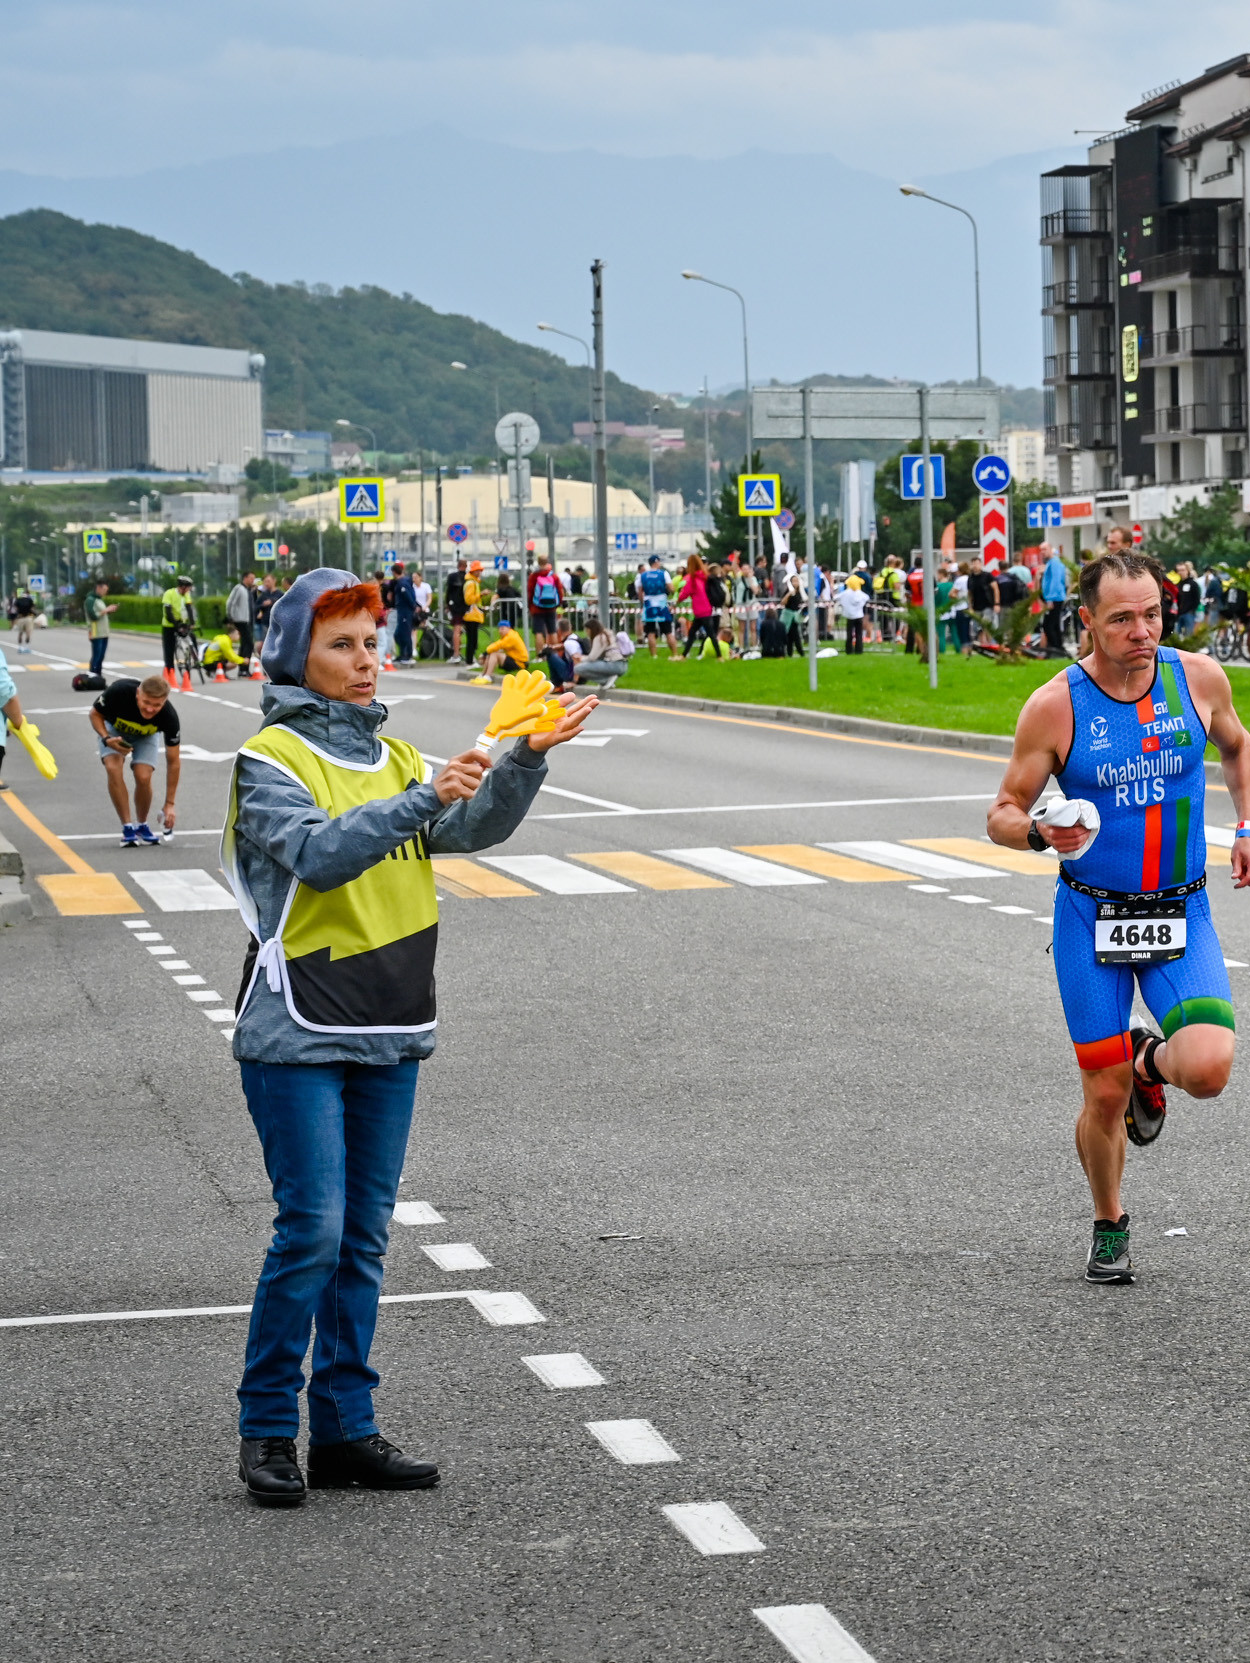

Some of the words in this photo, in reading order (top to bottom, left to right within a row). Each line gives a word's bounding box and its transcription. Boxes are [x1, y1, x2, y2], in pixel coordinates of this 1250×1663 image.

[1143, 716, 1185, 736] ТЕМП
[1093, 737, 1108, 746] World
[1096, 749, 1183, 788] Khabibullin
[1115, 777, 1165, 807] RUS
[1109, 924, 1172, 946] 4648
